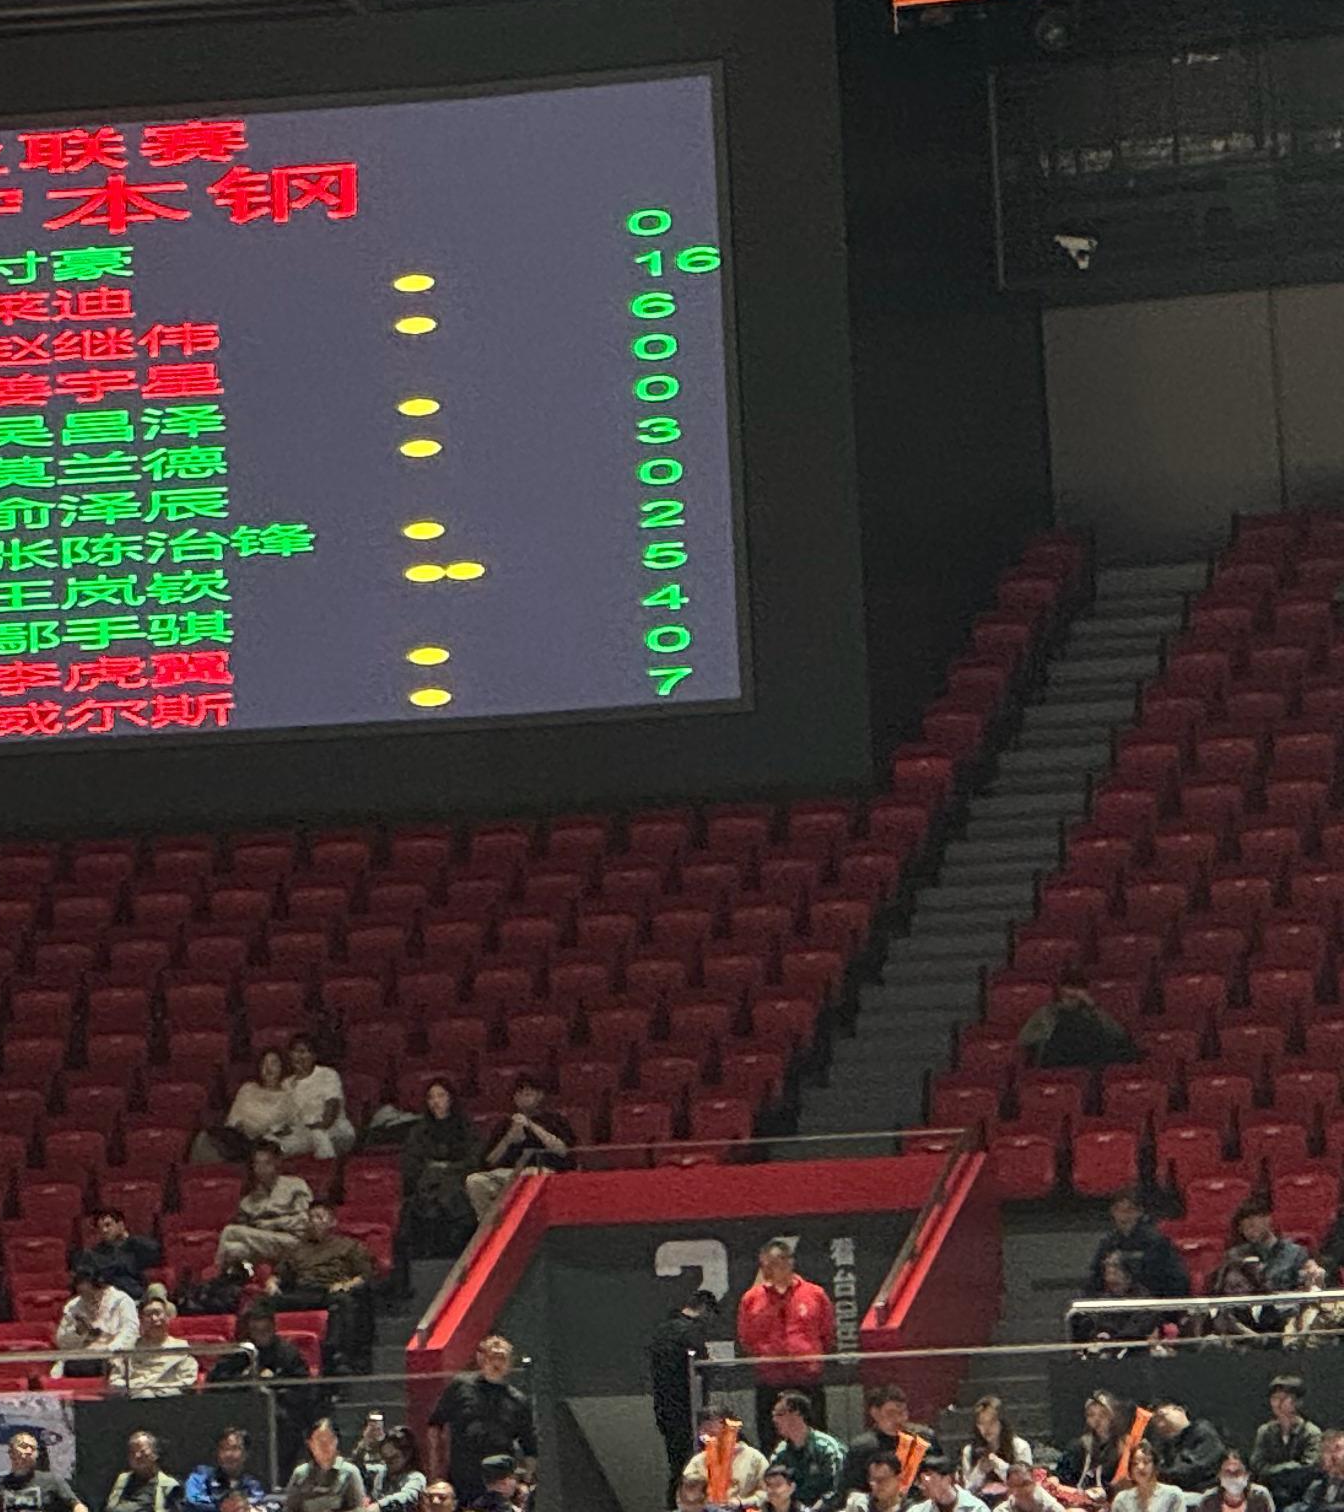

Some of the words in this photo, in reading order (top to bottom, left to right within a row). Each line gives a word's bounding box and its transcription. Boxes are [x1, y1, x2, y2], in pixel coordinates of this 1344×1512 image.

[625, 209, 672, 237] 0
[636, 246, 721, 276] 16
[628, 291, 676, 319] 6
[631, 333, 678, 361] 0
[633, 374, 680, 402] 0
[638, 416, 681, 444] 3
[635, 458, 683, 485] 0
[640, 500, 684, 528] 2
[643, 541, 687, 570] 5
[642, 583, 688, 610] 4
[644, 625, 692, 653] 0
[649, 667, 691, 696] 7
